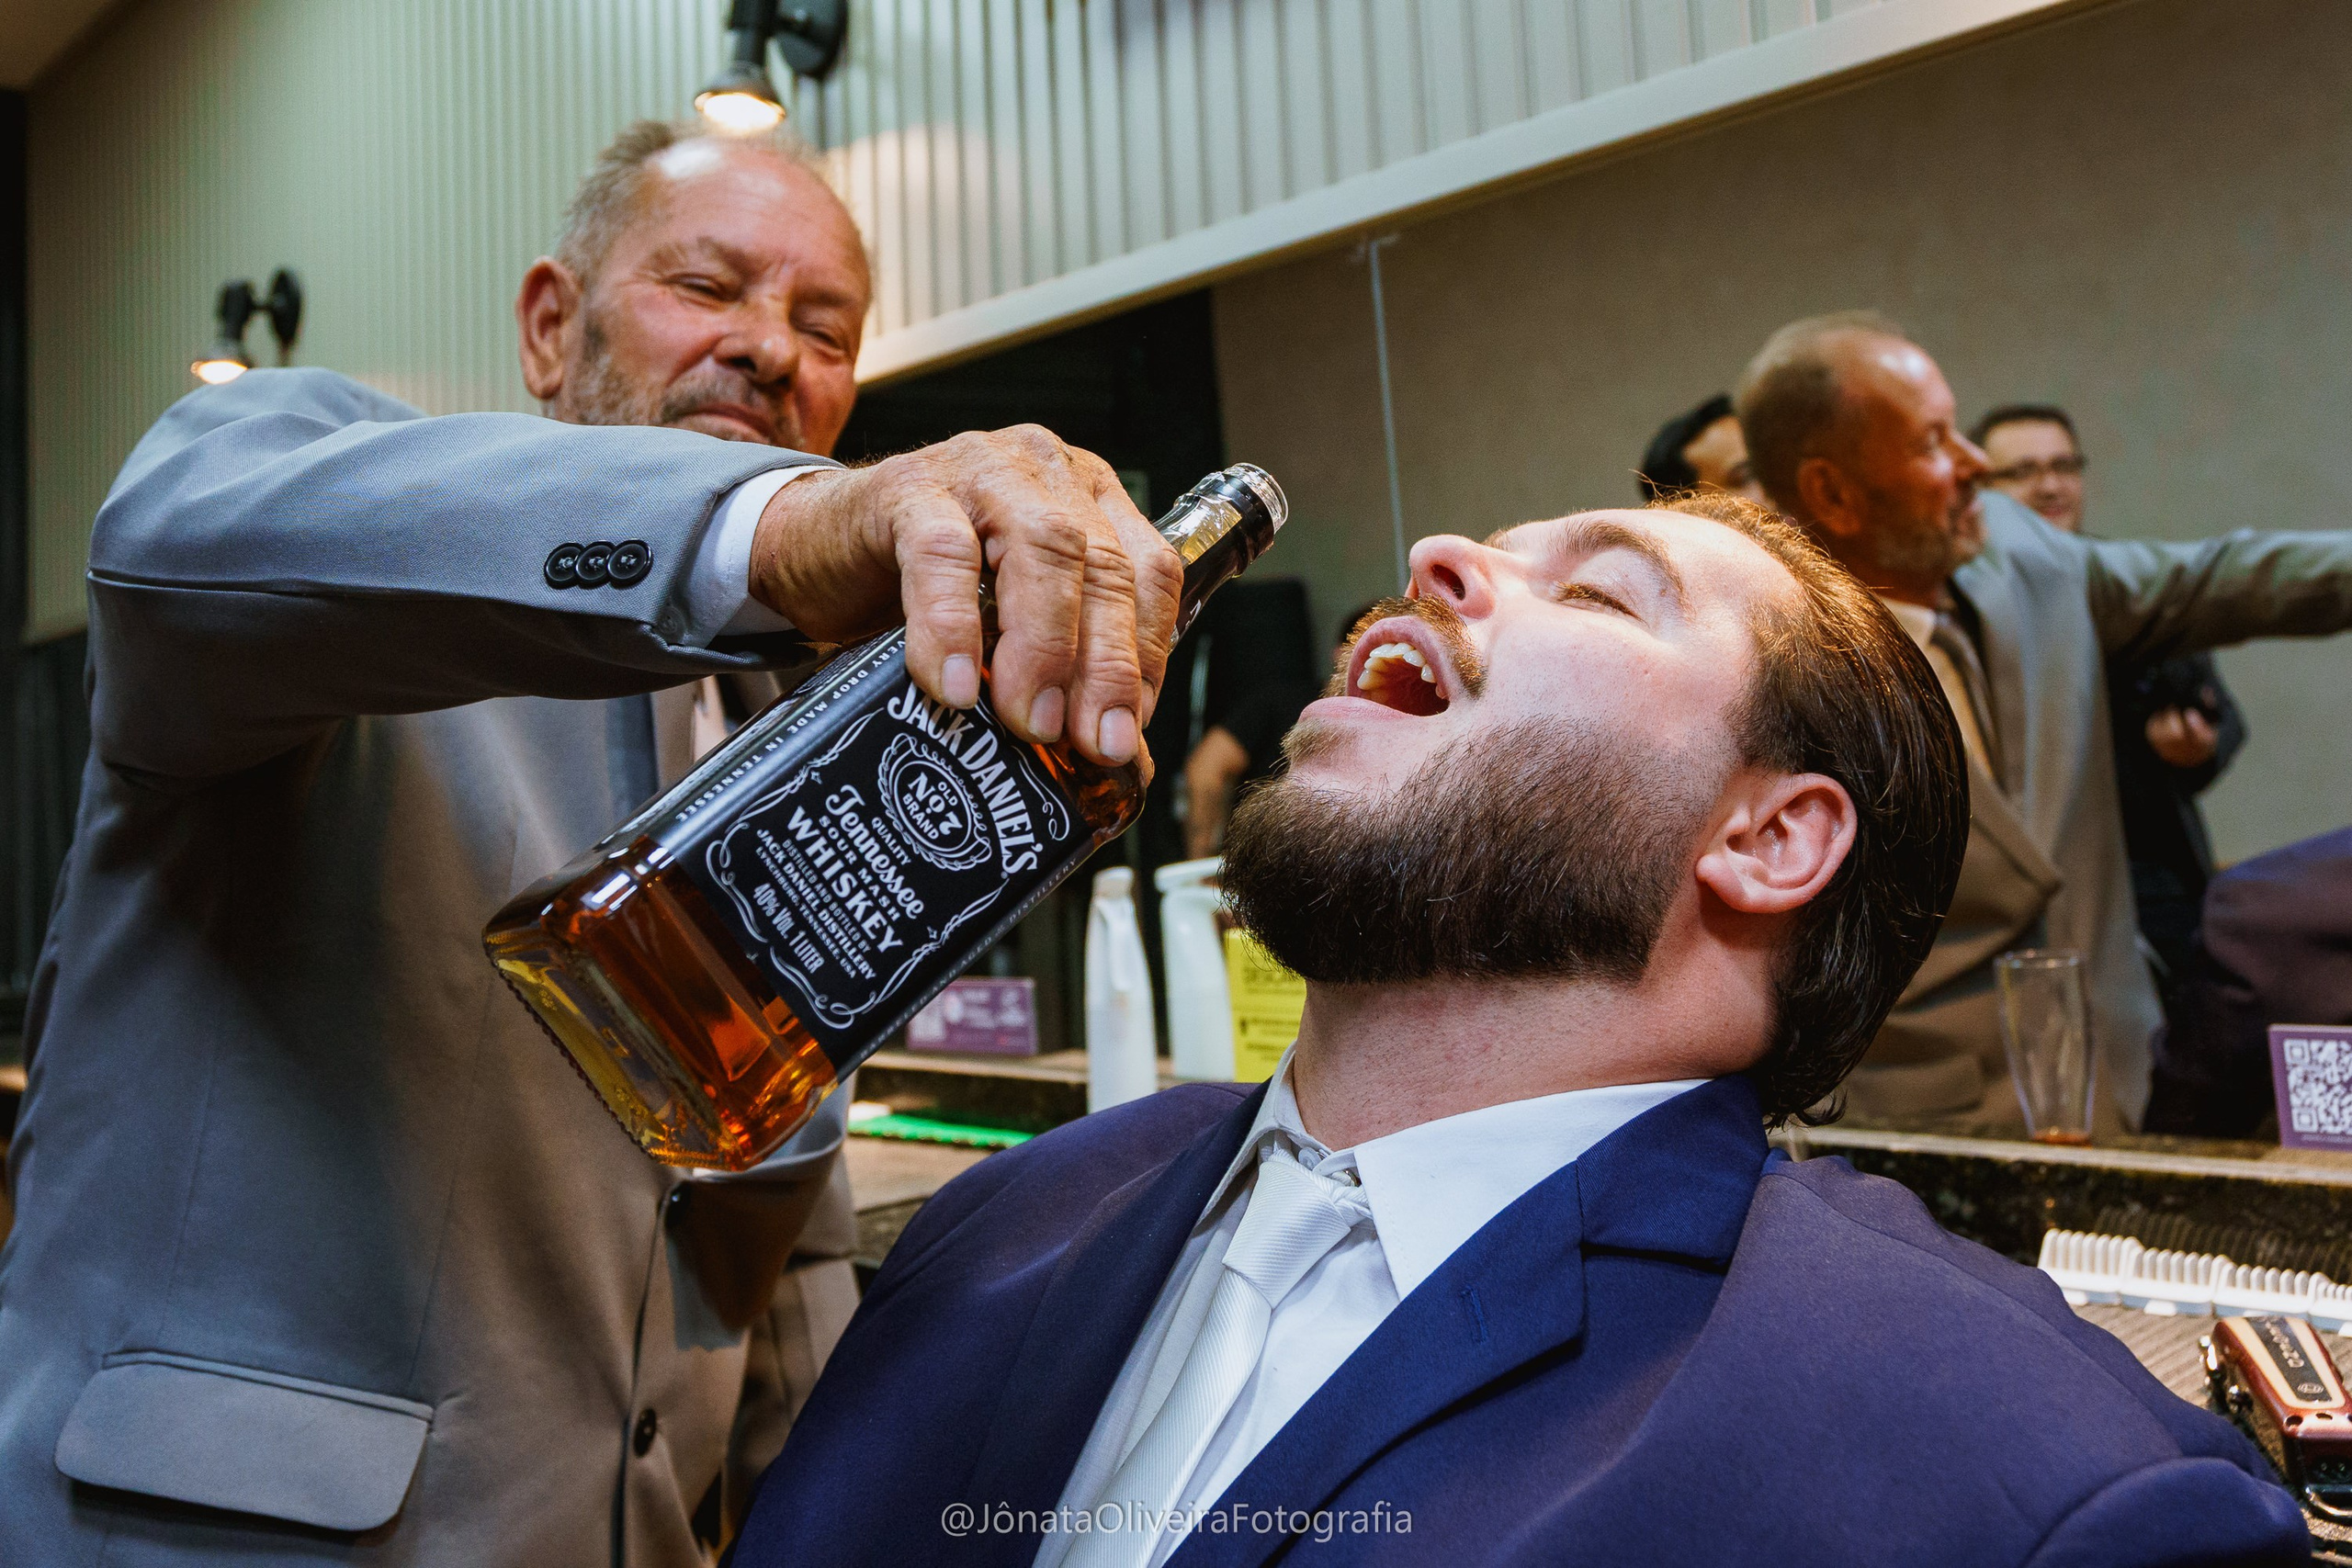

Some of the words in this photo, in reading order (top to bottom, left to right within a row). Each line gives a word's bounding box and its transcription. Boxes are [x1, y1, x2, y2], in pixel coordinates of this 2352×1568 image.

[832, 669, 869, 700] DROP
[872, 639, 907, 668] VERY
[764, 737, 784, 752] IN
[786, 700, 829, 734] MADE
[675, 753, 763, 823] TENNESSEE
[887, 682, 974, 756] JACK
[957, 728, 1044, 874] DANIEL'S
[937, 781, 958, 807] OLD
[825, 784, 924, 919] Tennessee
[871, 817, 911, 865] QUALITY
[902, 793, 940, 840] BRAND
[782, 839, 817, 885] DISTILLED
[815, 883, 831, 904] AND
[829, 901, 861, 942] BOTTLED
[858, 940, 872, 953] BY
[786, 806, 904, 953] WHISKEY
[819, 815, 858, 864] SOUR
[857, 867, 901, 922] MASH
[752, 883, 781, 917] 40%
[793, 938, 825, 974] LITER
[756, 829, 787, 864] JACK
[783, 863, 821, 912] DANIEL
[818, 908, 876, 980] DISTILLERY
[933, 969, 957, 993] AND
[960, 935, 993, 967] AGED
[1009, 857, 1077, 922] DISTILLERY
[839, 957, 857, 978] USA
